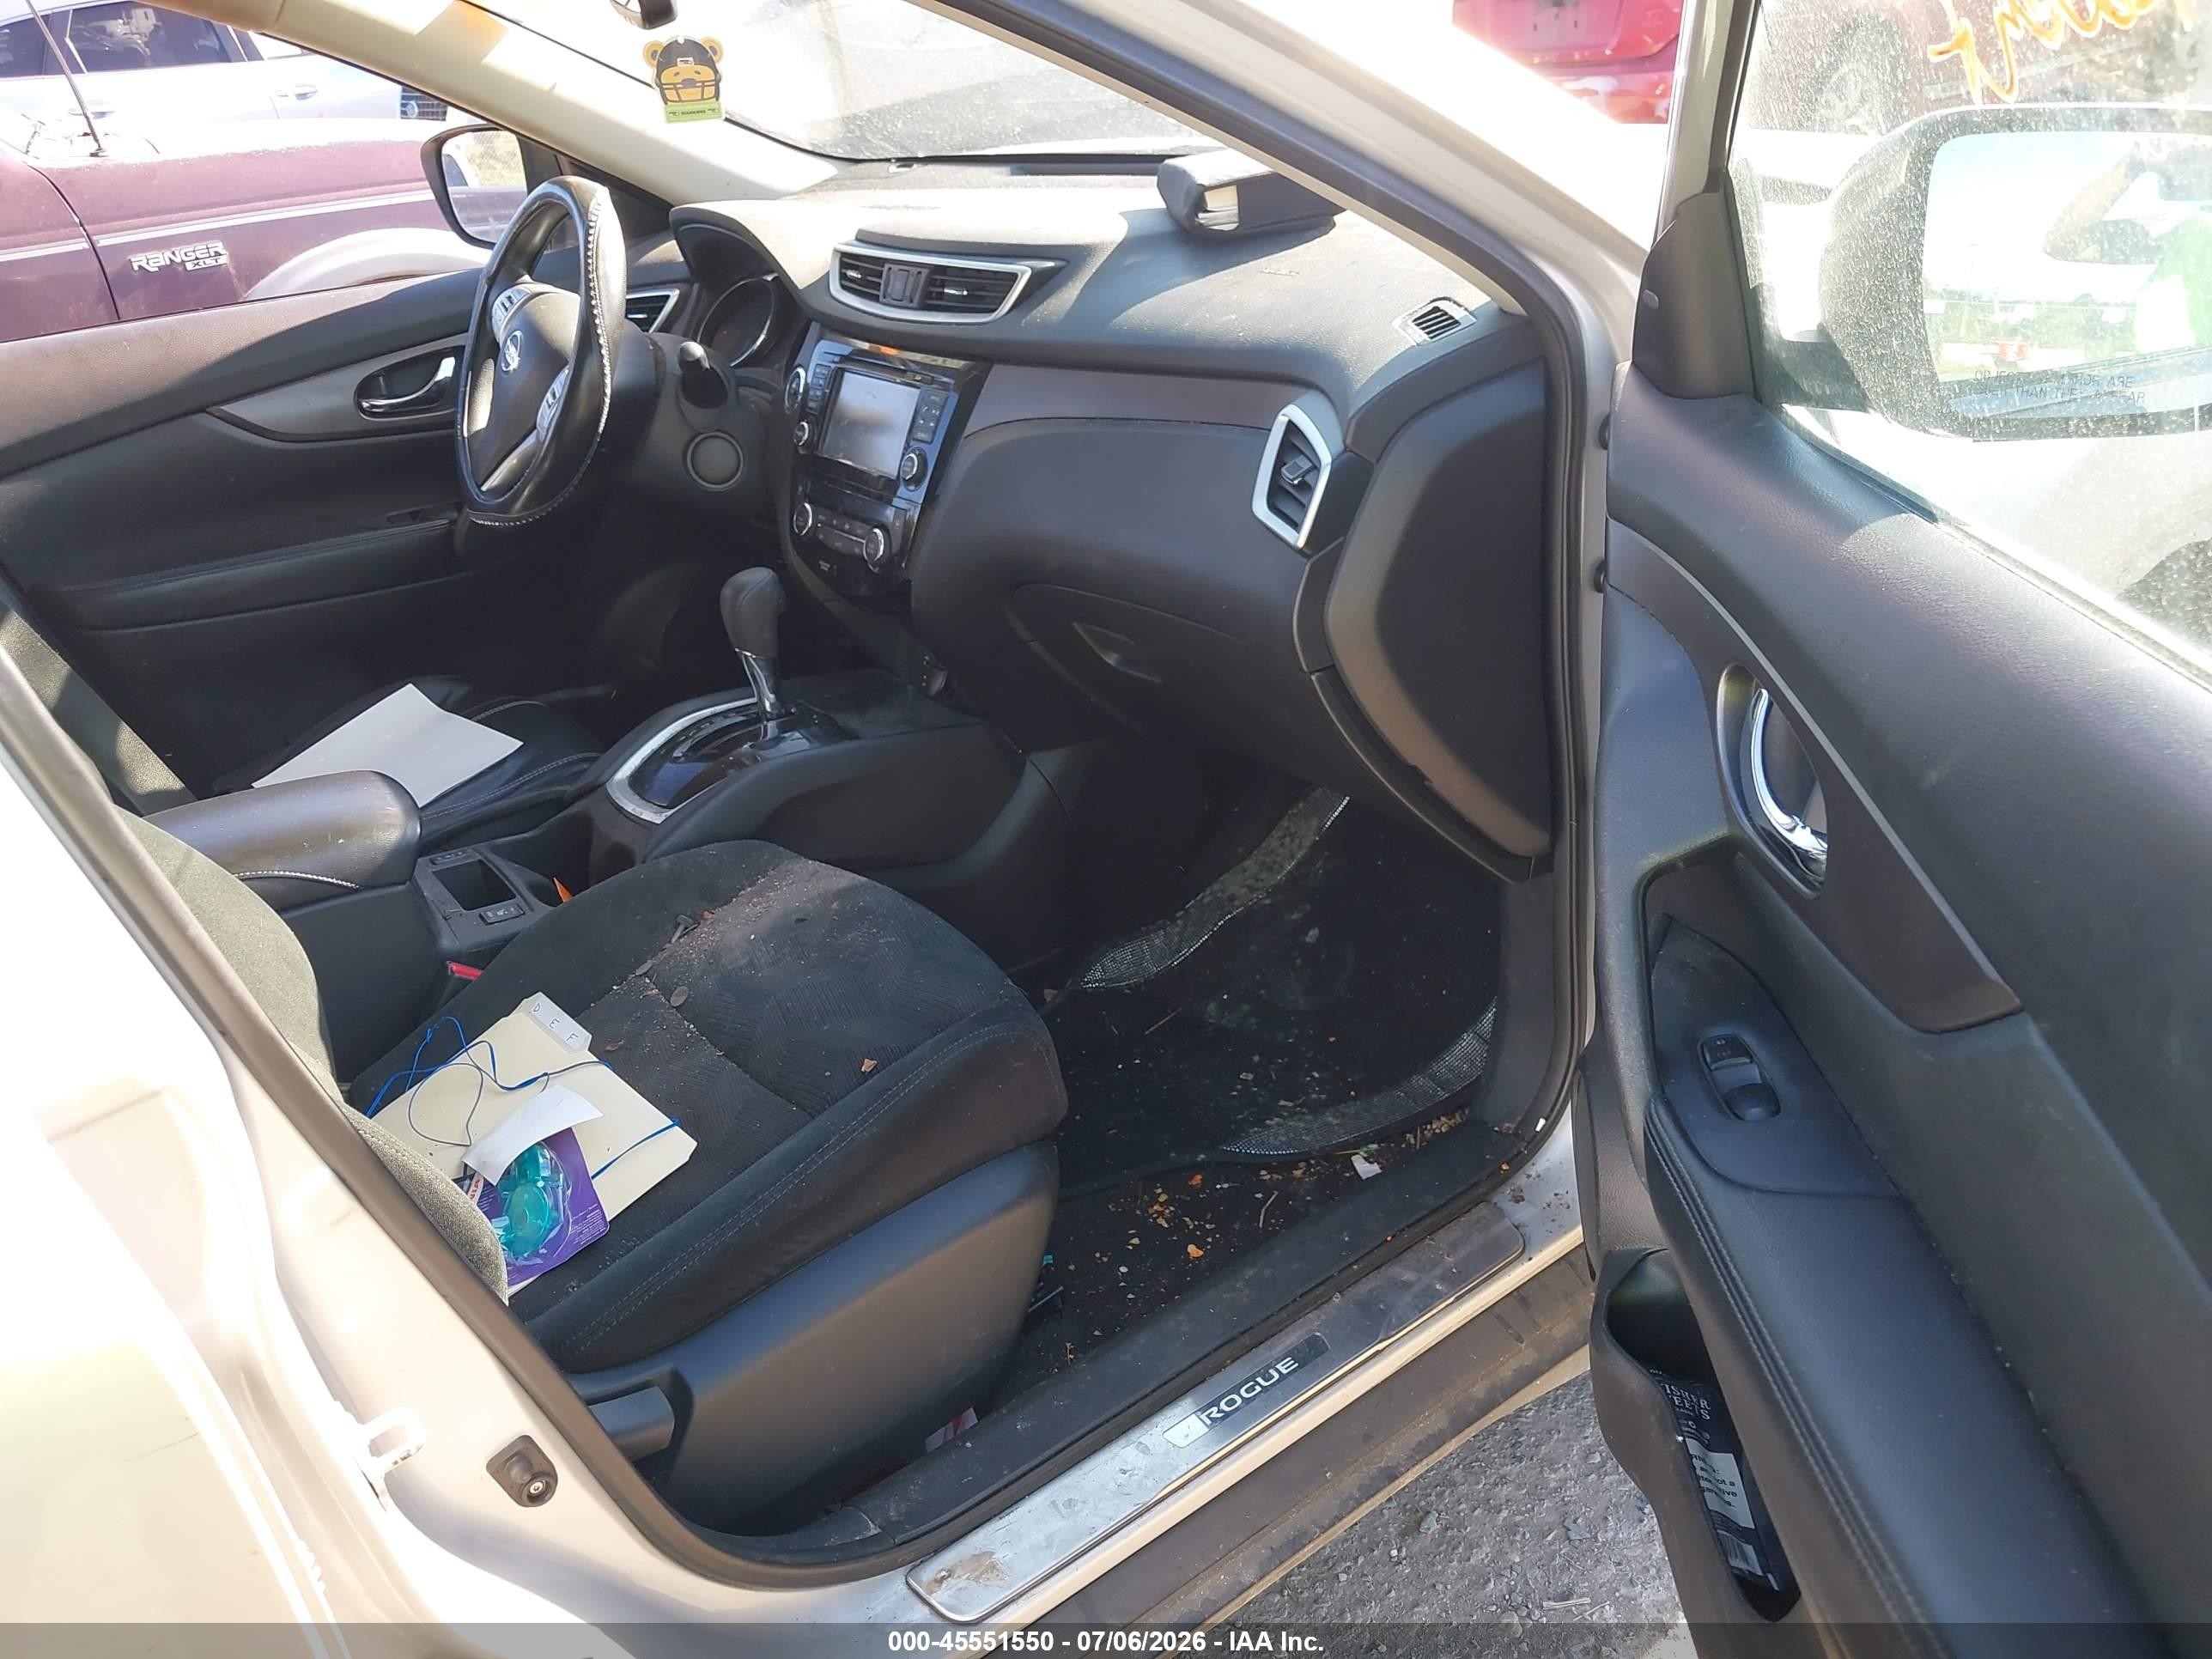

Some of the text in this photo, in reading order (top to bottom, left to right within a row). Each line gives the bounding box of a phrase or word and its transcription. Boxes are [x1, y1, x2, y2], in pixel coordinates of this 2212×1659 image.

[130, 240, 228, 272] RANGER
[191, 258, 221, 269] XLT
[1199, 1356, 1299, 1426] ROGUE
